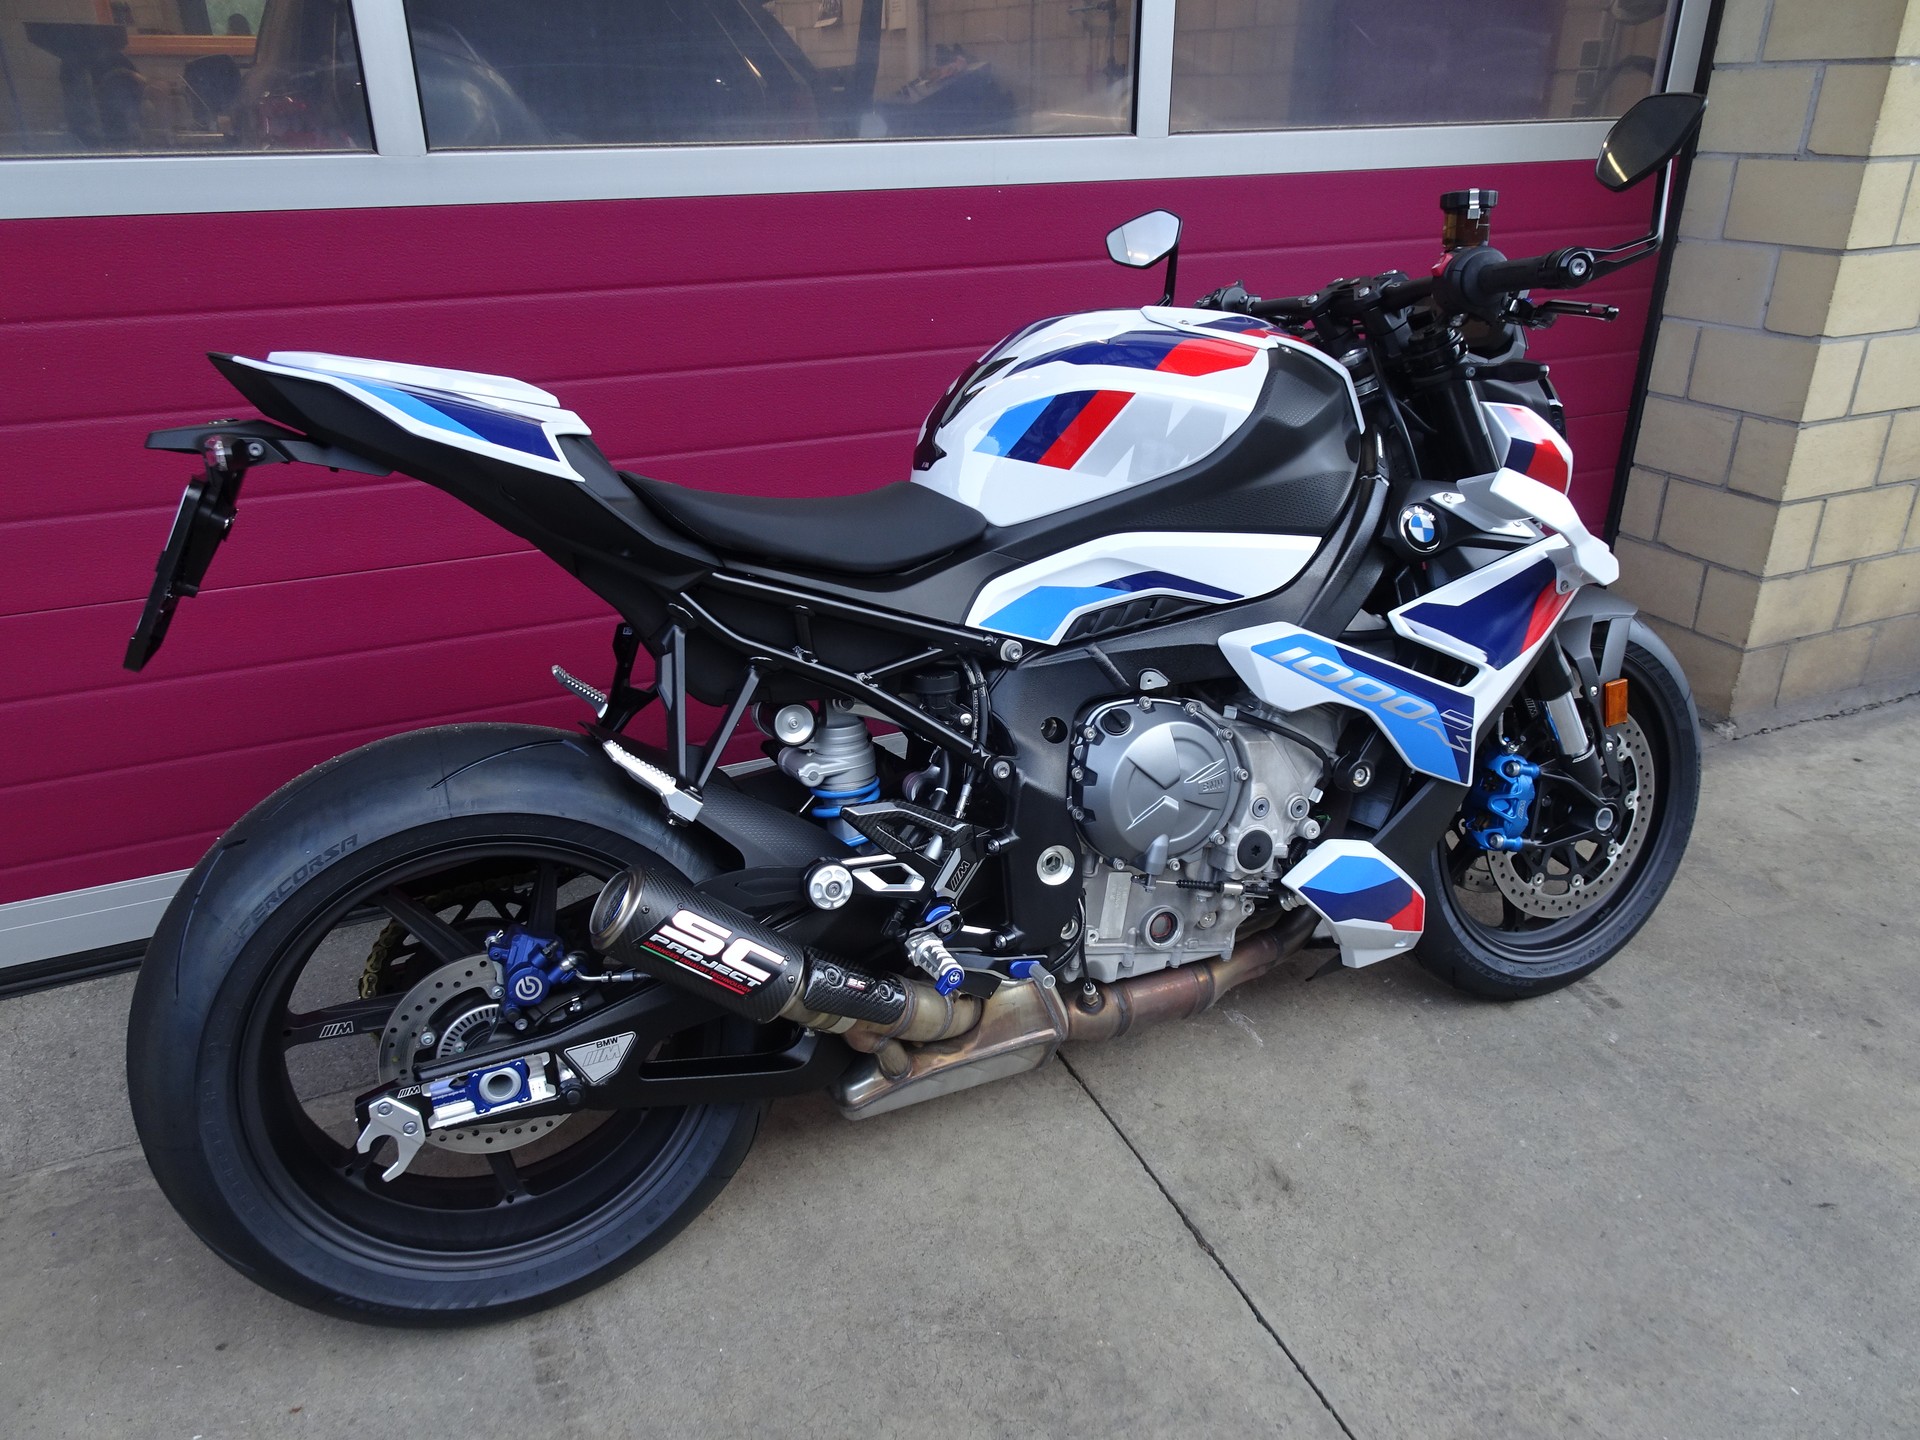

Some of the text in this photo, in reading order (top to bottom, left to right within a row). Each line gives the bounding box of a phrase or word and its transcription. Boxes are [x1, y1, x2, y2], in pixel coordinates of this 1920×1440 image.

[643, 941, 753, 993] ADVANCED EXHAUST TECHNOLOGY
[649, 933, 762, 988] PROJECT
[658, 909, 786, 983] SC
[596, 1037, 618, 1049] BMW
